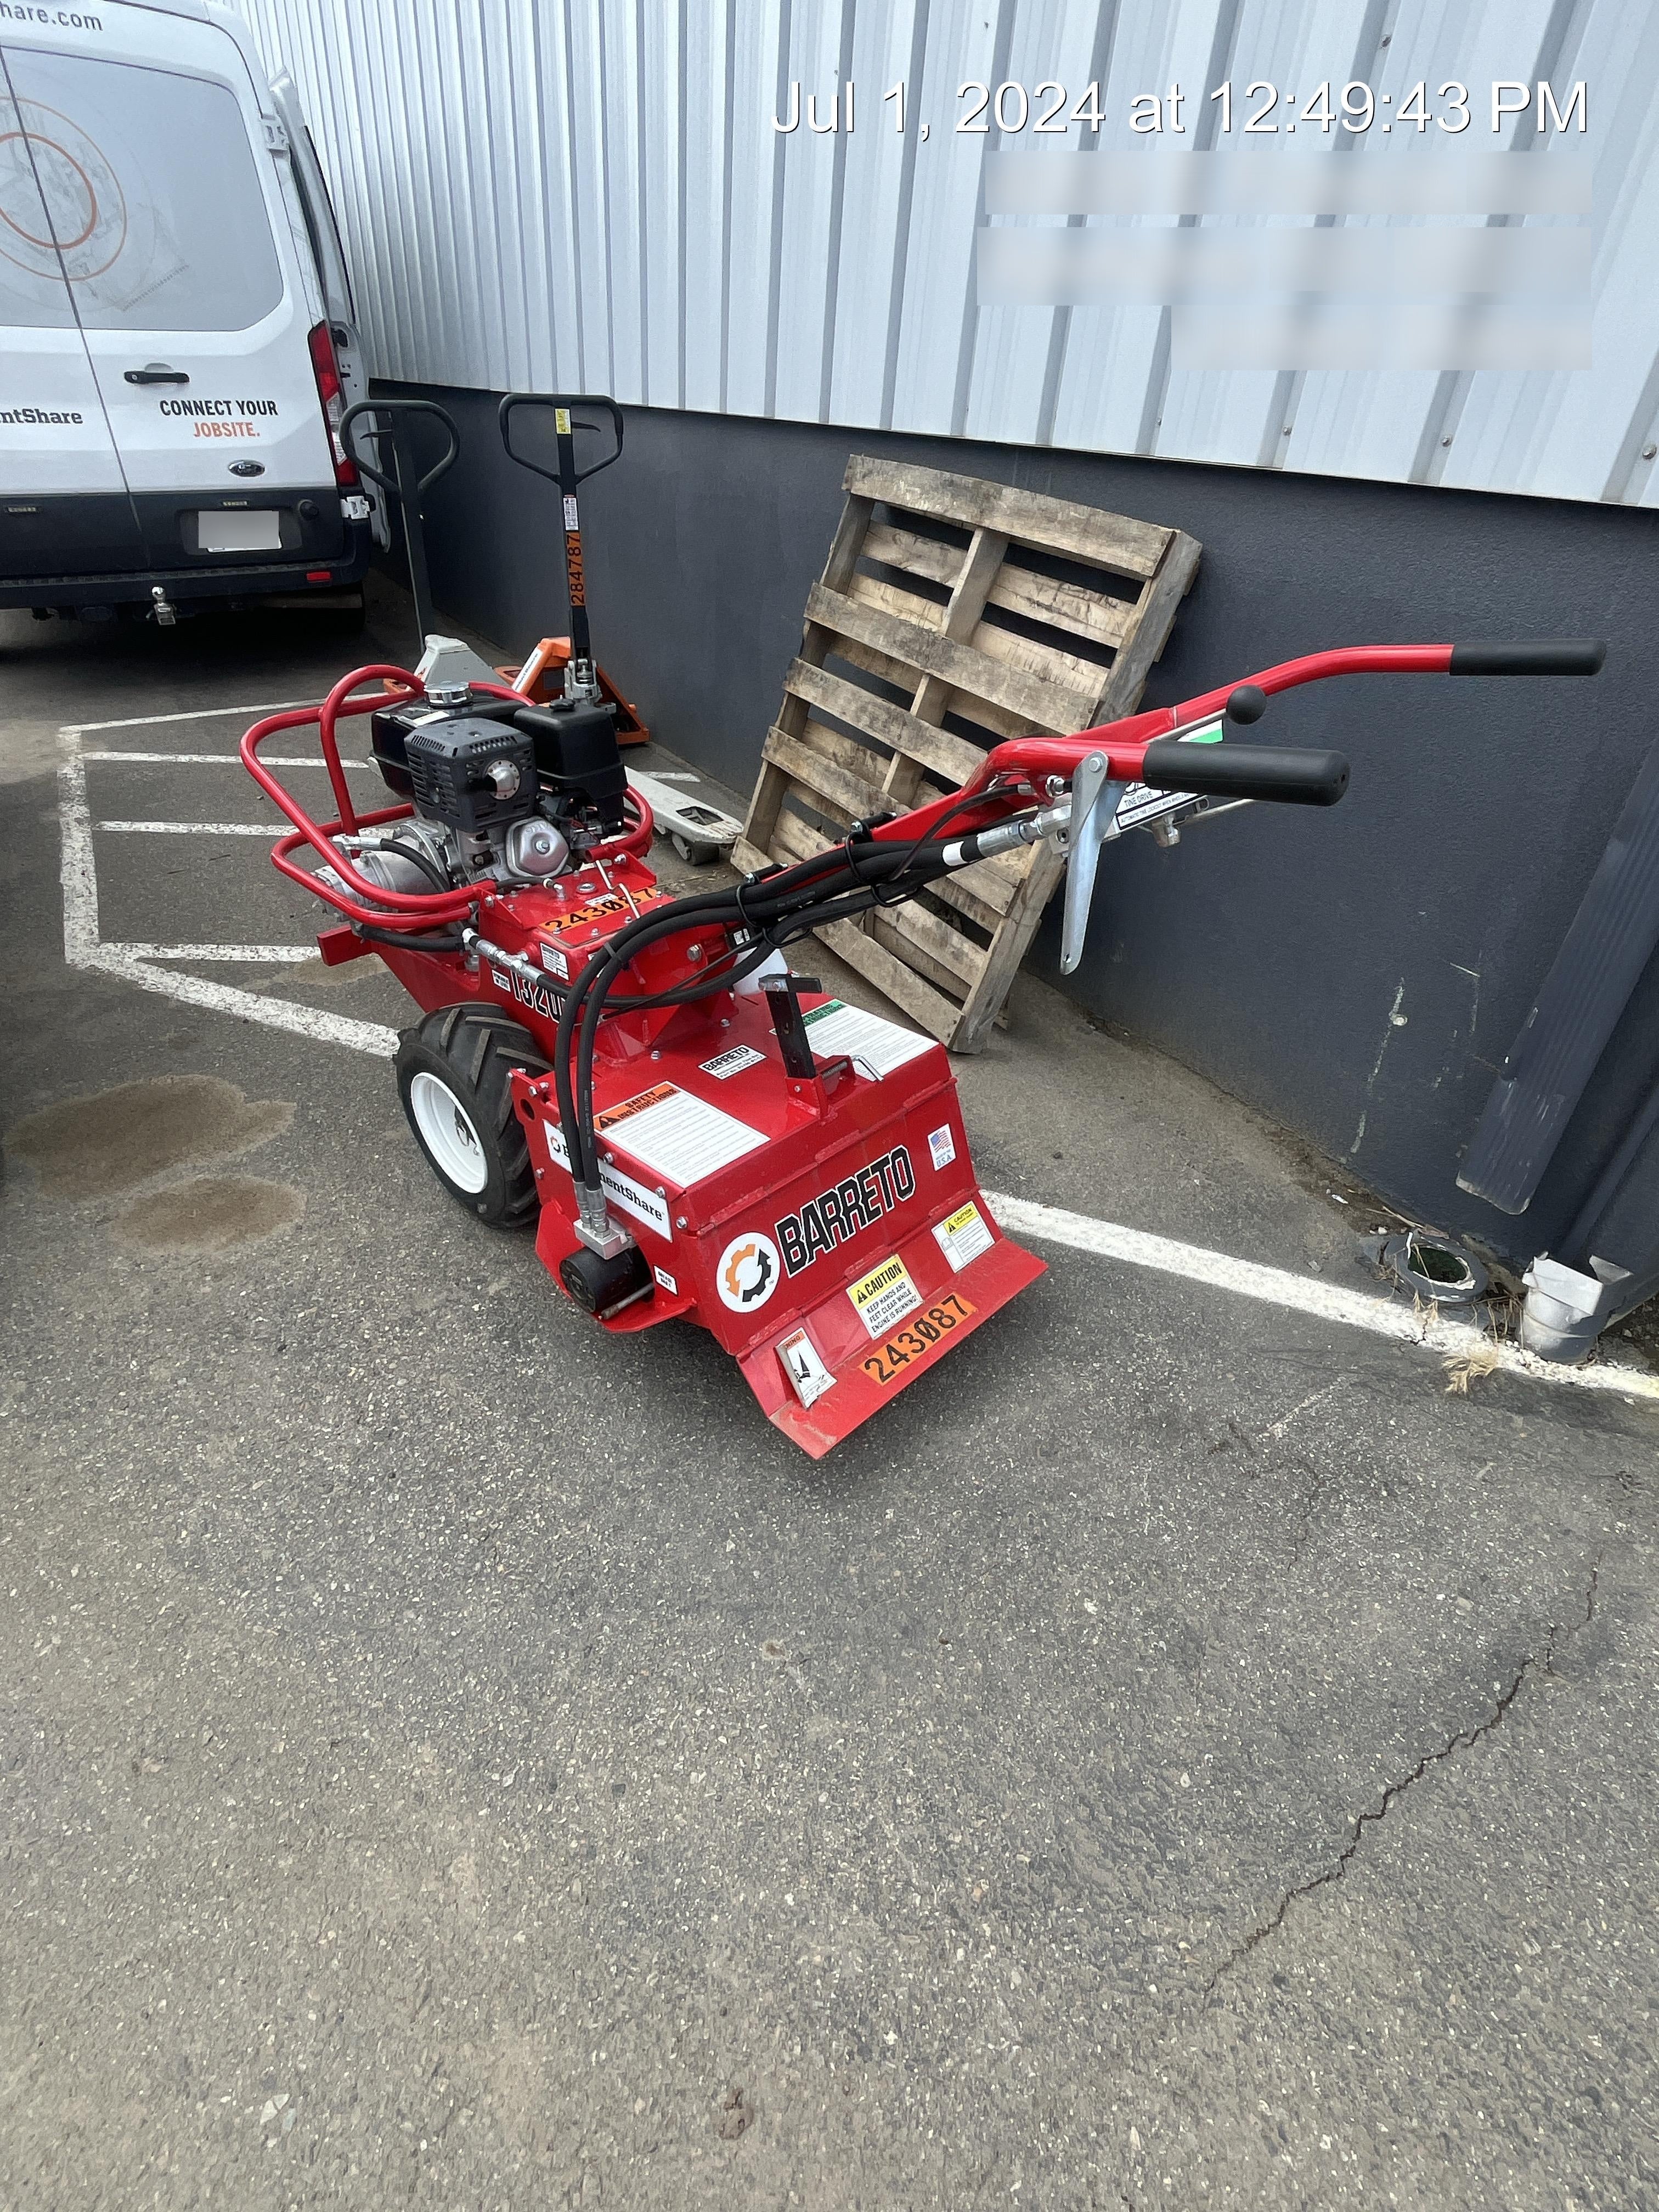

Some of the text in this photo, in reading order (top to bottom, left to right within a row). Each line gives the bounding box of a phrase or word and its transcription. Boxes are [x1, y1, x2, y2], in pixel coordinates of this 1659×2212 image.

[0, 408, 83, 424] ntShare
[160, 400, 279, 416] CONNECT YOUR
[194, 422, 260, 437] JOBSITE.
[567, 534, 585, 605] 284787
[545, 887, 653, 932] 243087
[510, 969, 566, 1024] 1320
[702, 1046, 749, 1071] BARRETO
[625, 1090, 657, 1108] SAFETY
[774, 1144, 916, 1278] BARRETO
[953, 1207, 972, 1222] CAUTION
[864, 1262, 902, 1296] CAUTION
[866, 1282, 906, 1314] KEEP HANDS AND
[869, 1288, 912, 1323] FEET CLEAR WHILE
[871, 1314, 890, 1333] ENGINE
[890, 1311, 896, 1319] IS
[864, 1294, 968, 1383] 243087
